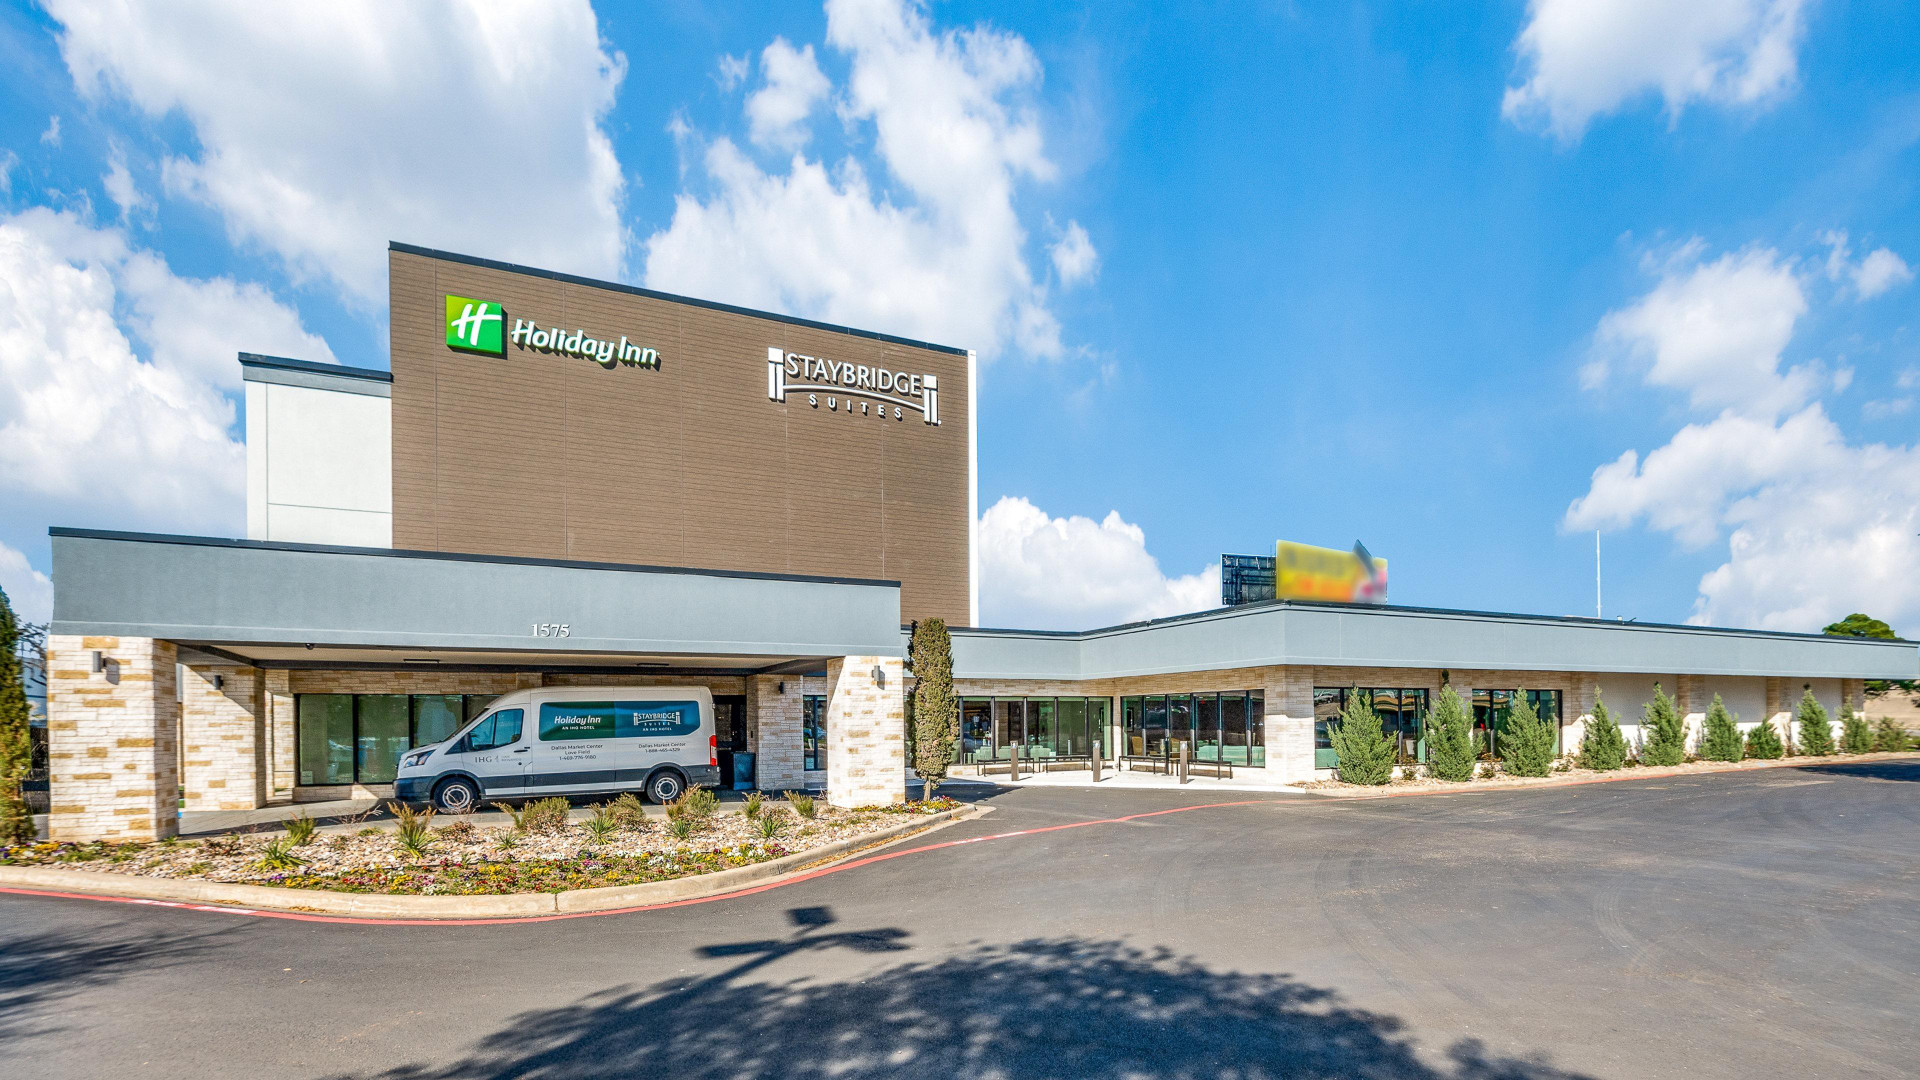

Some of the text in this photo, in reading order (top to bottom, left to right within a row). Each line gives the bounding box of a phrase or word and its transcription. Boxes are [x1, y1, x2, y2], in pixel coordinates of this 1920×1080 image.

[511, 318, 657, 365] Holiday Inn
[785, 352, 922, 395] STAYBRIDGE
[808, 394, 902, 419] SUITES
[532, 623, 570, 637] 1575
[554, 715, 601, 725] Holiday Inn
[638, 712, 676, 720] STAYBRIDGE
[475, 755, 492, 763] IHG
